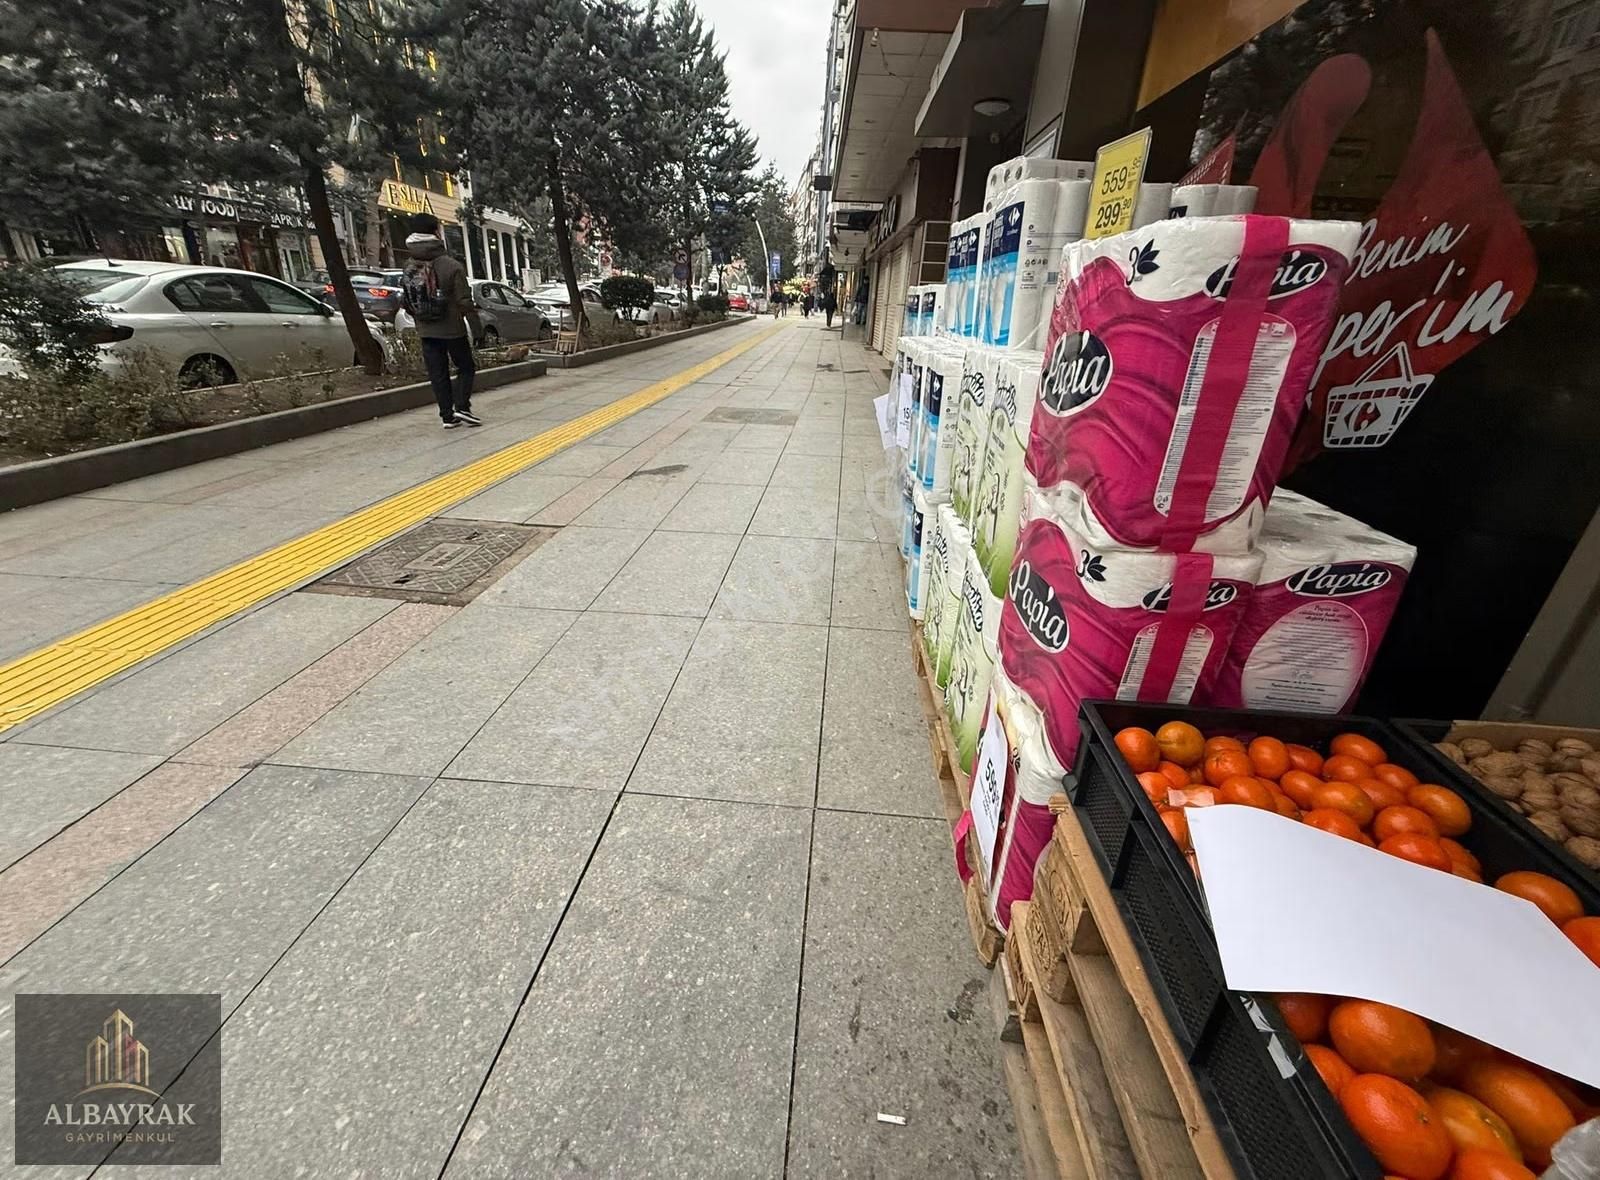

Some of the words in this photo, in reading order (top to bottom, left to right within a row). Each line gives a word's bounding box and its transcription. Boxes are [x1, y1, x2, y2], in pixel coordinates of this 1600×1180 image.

[1101, 166, 1128, 195] 559
[165, 194, 235, 217] LLYOOD
[1095, 202, 1121, 229] 299
[1211, 250, 1322, 298] Pia
[1345, 216, 1470, 286] Benim
[1308, 259, 1514, 390] perim
[1040, 330, 1107, 414] Papia
[1009, 558, 1065, 647] Papia
[1293, 563, 1385, 595] Papia
